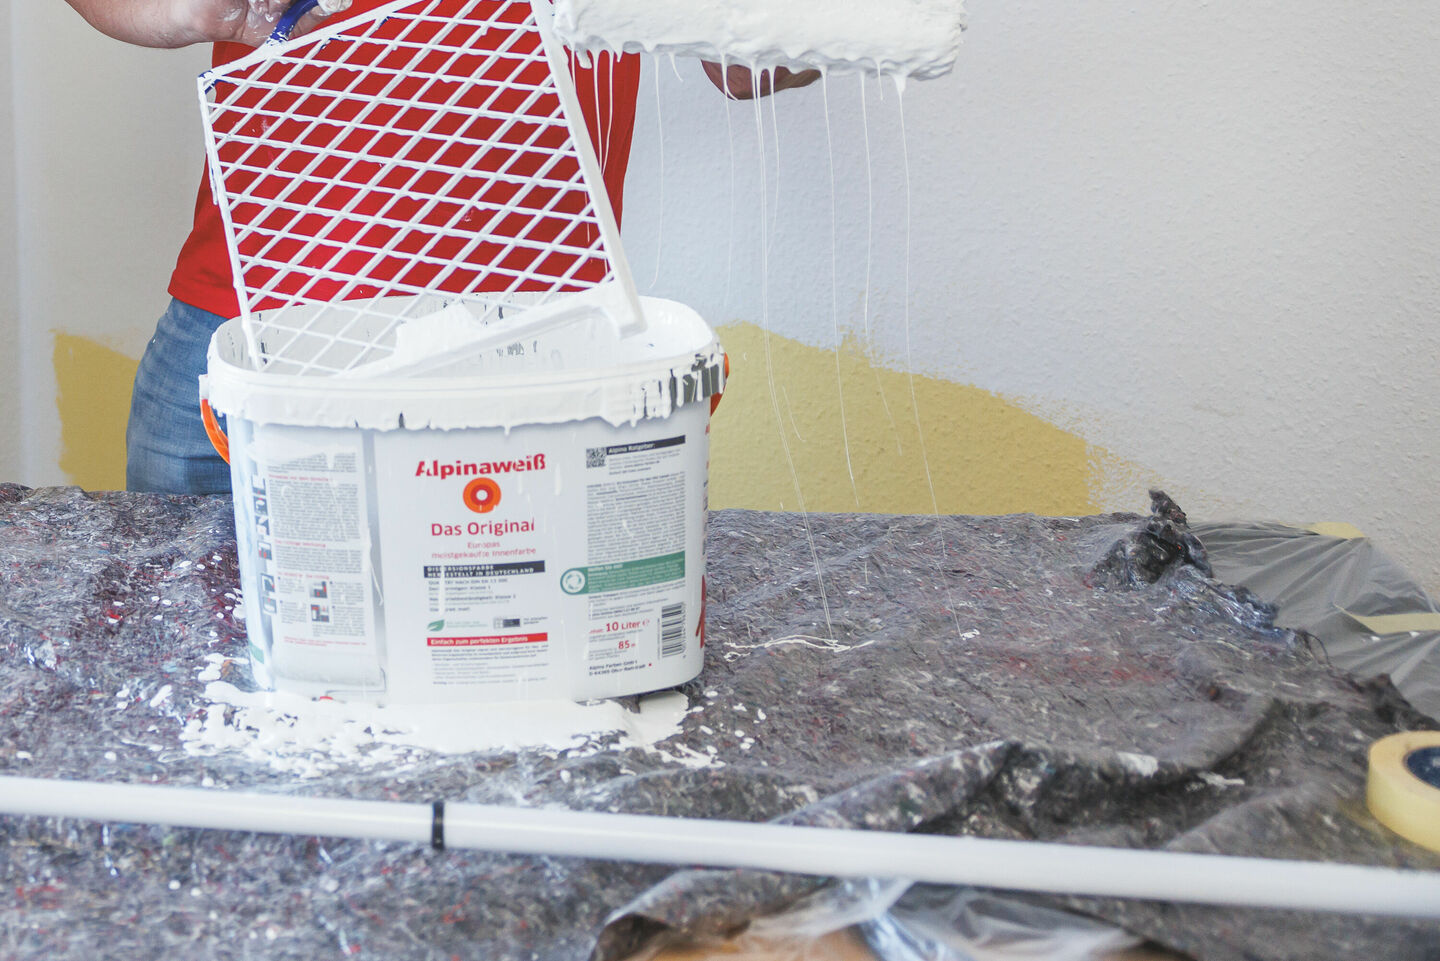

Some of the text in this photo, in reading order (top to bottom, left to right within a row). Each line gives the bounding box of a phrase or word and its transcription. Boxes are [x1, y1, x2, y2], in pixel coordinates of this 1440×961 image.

[415, 452, 546, 480] Alpinaweiß
[431, 517, 535, 537] Das Original
[606, 621, 619, 633] 10
[621, 620, 641, 631] Liter
[470, 637, 500, 646] perfekten
[501, 635, 528, 644] Ergebnis
[618, 639, 630, 650] 85
